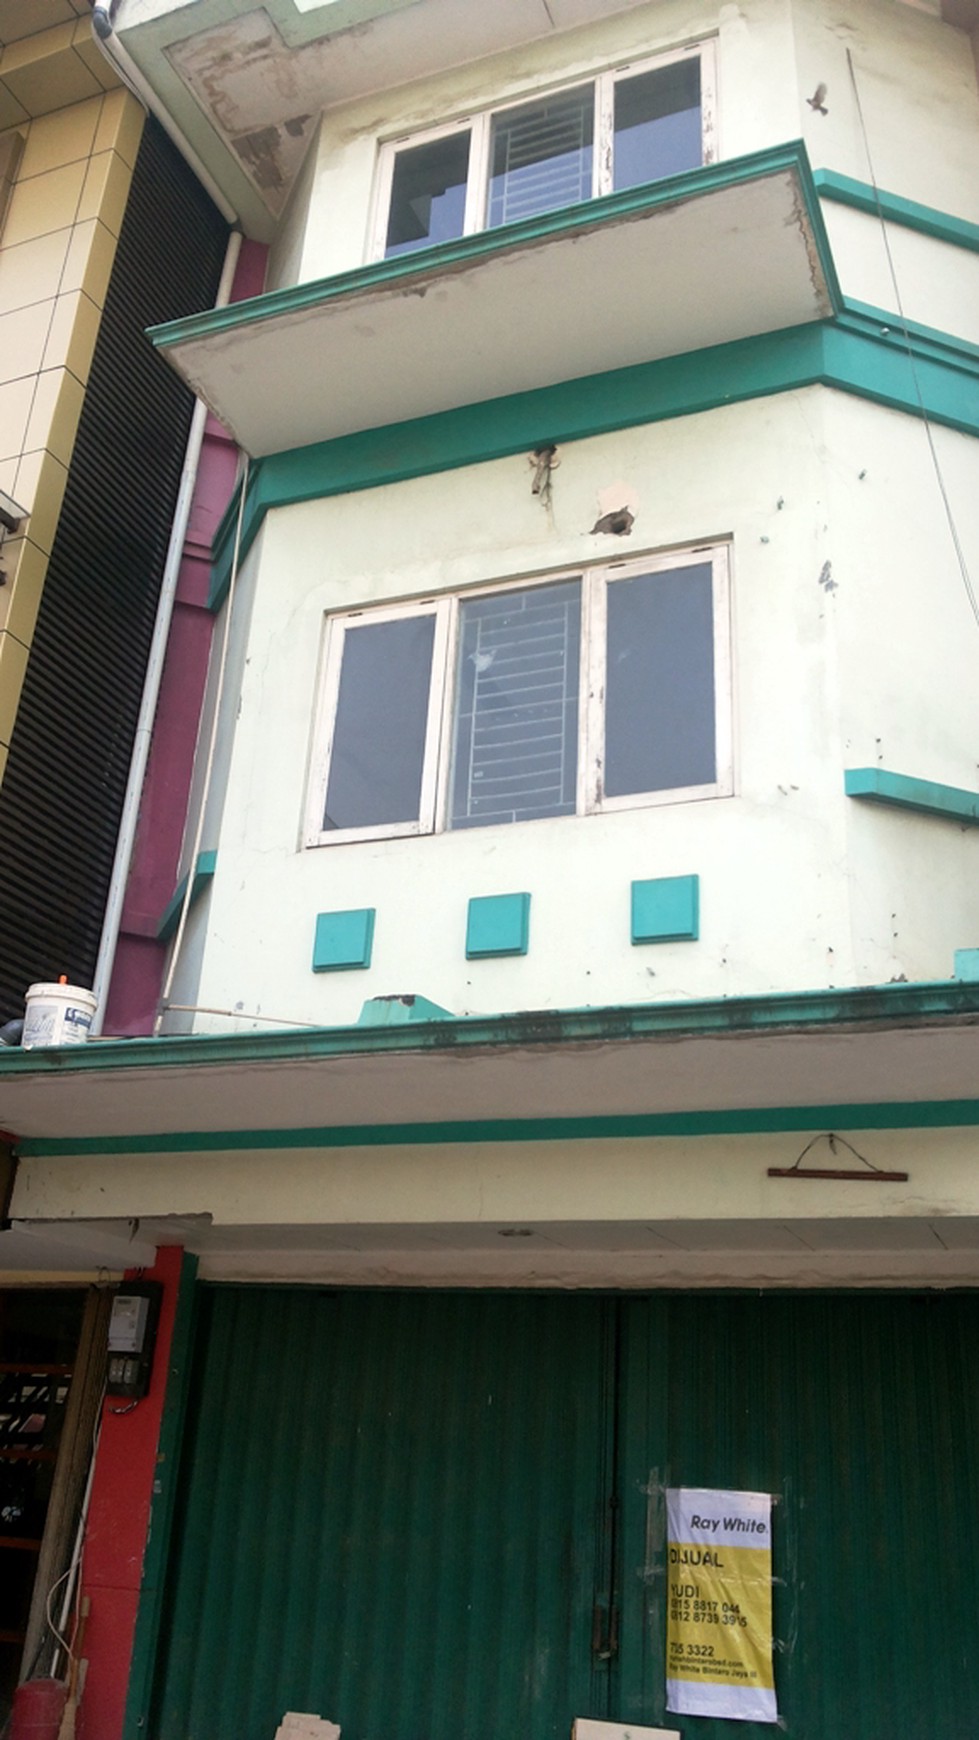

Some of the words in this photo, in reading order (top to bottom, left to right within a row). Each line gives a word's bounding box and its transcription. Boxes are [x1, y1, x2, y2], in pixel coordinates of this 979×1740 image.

[690, 1514, 720, 1533] Ray
[670, 1548, 724, 1568] DIJUAL
[687, 1644, 714, 1657] 3322
